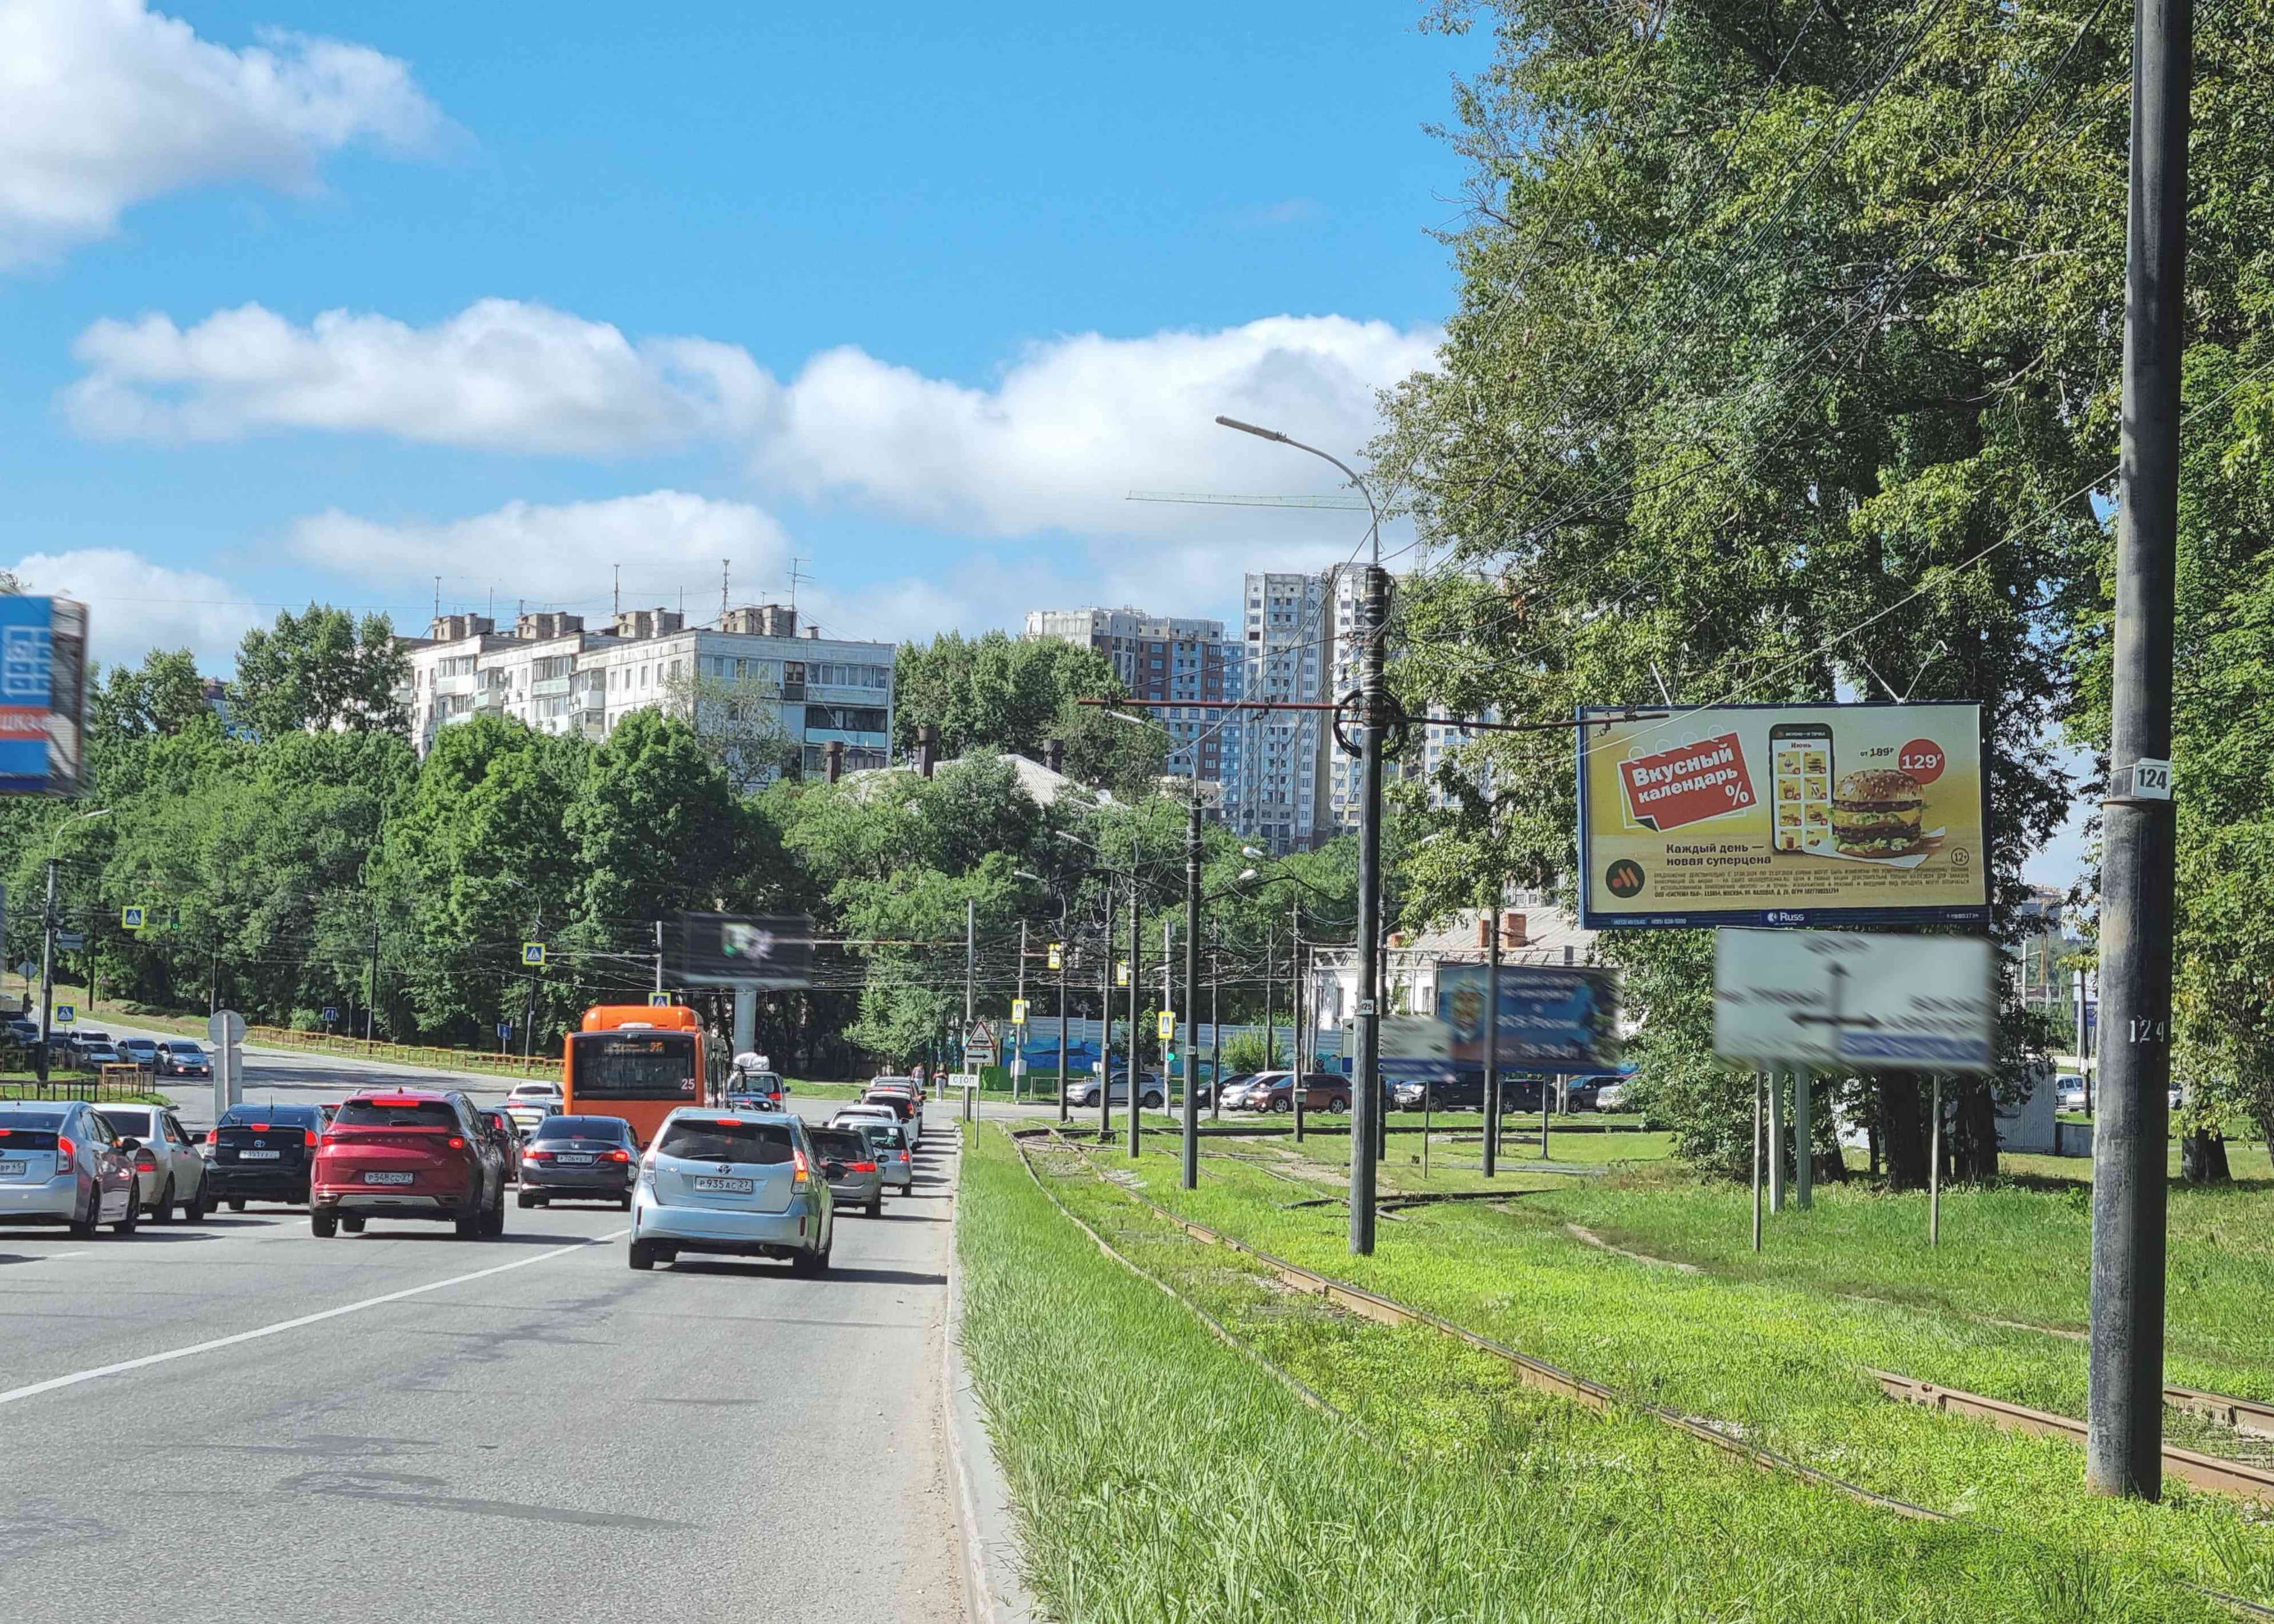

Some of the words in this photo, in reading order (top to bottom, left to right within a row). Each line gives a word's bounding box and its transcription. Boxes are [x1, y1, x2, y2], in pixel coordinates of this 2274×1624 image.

[1632, 743, 1734, 787] Вкусный
[2138, 768, 2167, 790] 124
[1638, 768, 1738, 803] календарь
[1724, 781, 1749, 806] %
[1666, 843, 1716, 854] Каждый
[1720, 844, 1749, 854] день
[1667, 857, 1703, 866] новая
[1707, 856, 1771, 867] суперцена
[1955, 853, 1967, 861] 12+
[1780, 912, 1805, 921] Russ
[2130, 1020, 2164, 1043] 124
[682, 1078, 696, 1090] 25
[953, 1076, 974, 1084] СТОП
